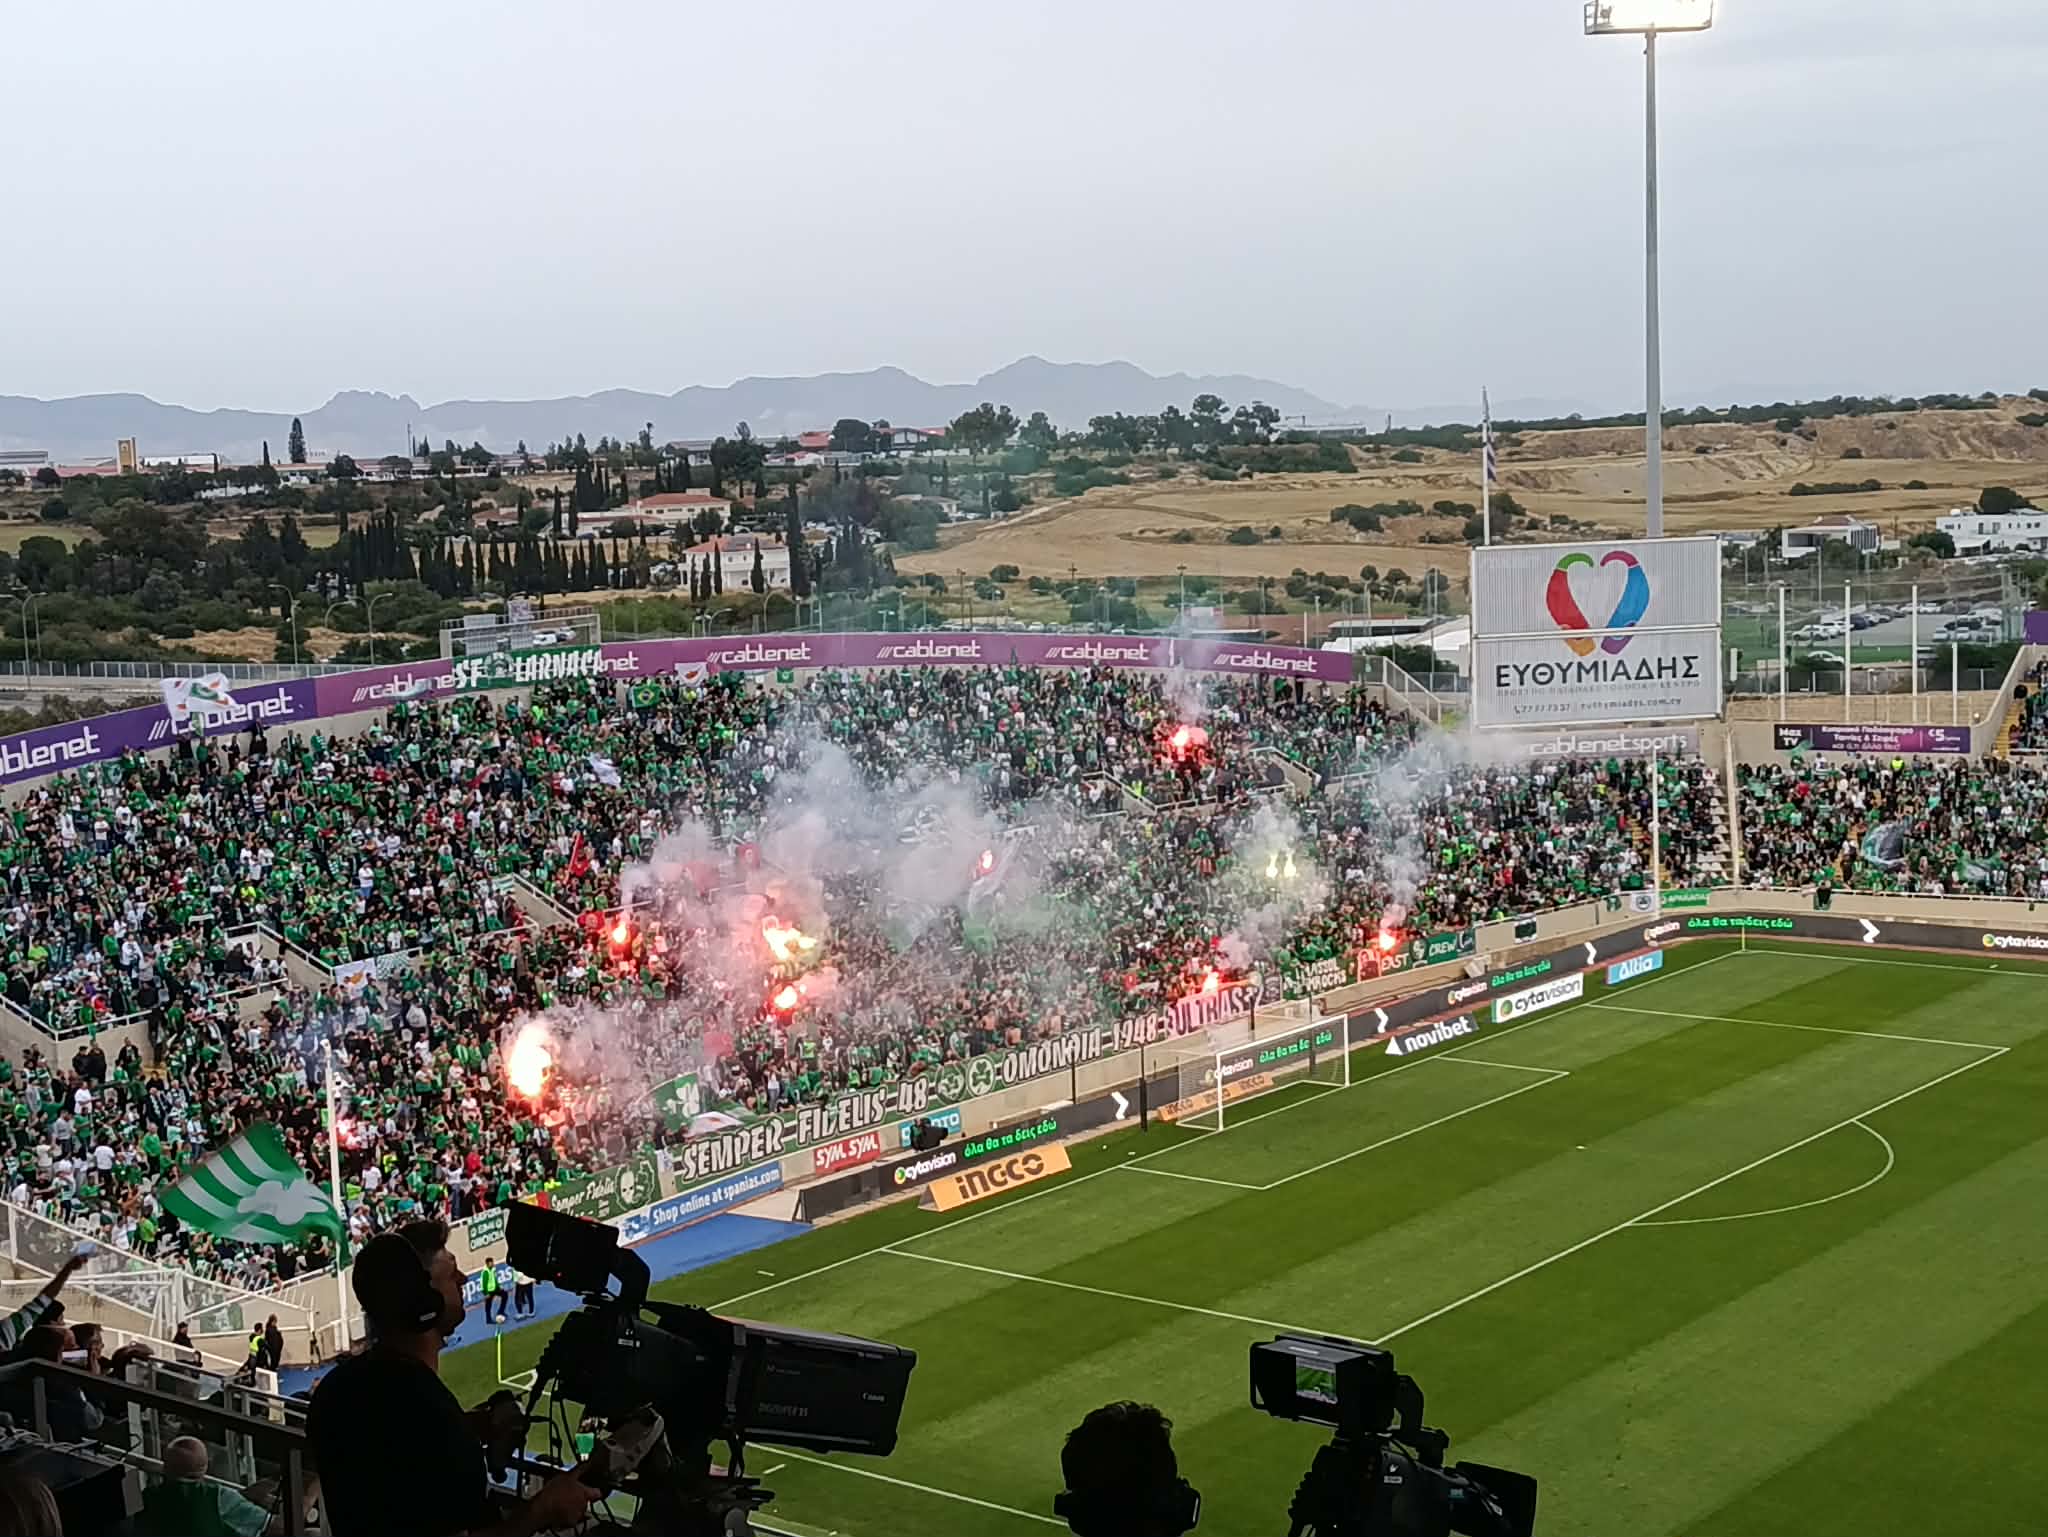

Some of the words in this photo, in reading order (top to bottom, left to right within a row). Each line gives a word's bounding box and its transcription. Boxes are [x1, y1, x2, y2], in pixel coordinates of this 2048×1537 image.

[721, 642, 811, 664] cablenet
[892, 640, 981, 658] cablenet
[1061, 642, 1150, 661] cablenet
[1229, 653, 1317, 673] cablenet
[1496, 655, 1700, 687] ΕΥΘΥΜΙΑΔΗΣ
[1994, 935, 2048, 949] cytavisio
[1515, 978, 1580, 1012] cytavision
[1404, 1016, 1473, 1053] novibet
[683, 1119, 783, 1180] SEMPER
[898, 1077, 928, 1113] 48
[815, 1145, 846, 1167] SYM
[849, 1134, 880, 1157] SYM
[985, 1137, 999, 1150] θα
[905, 1151, 957, 1180] cytavision
[653, 1205, 678, 1226] Shop
[680, 1194, 710, 1214] online
[711, 1187, 723, 1203] at
[724, 1168, 780, 1201] spanias.com
